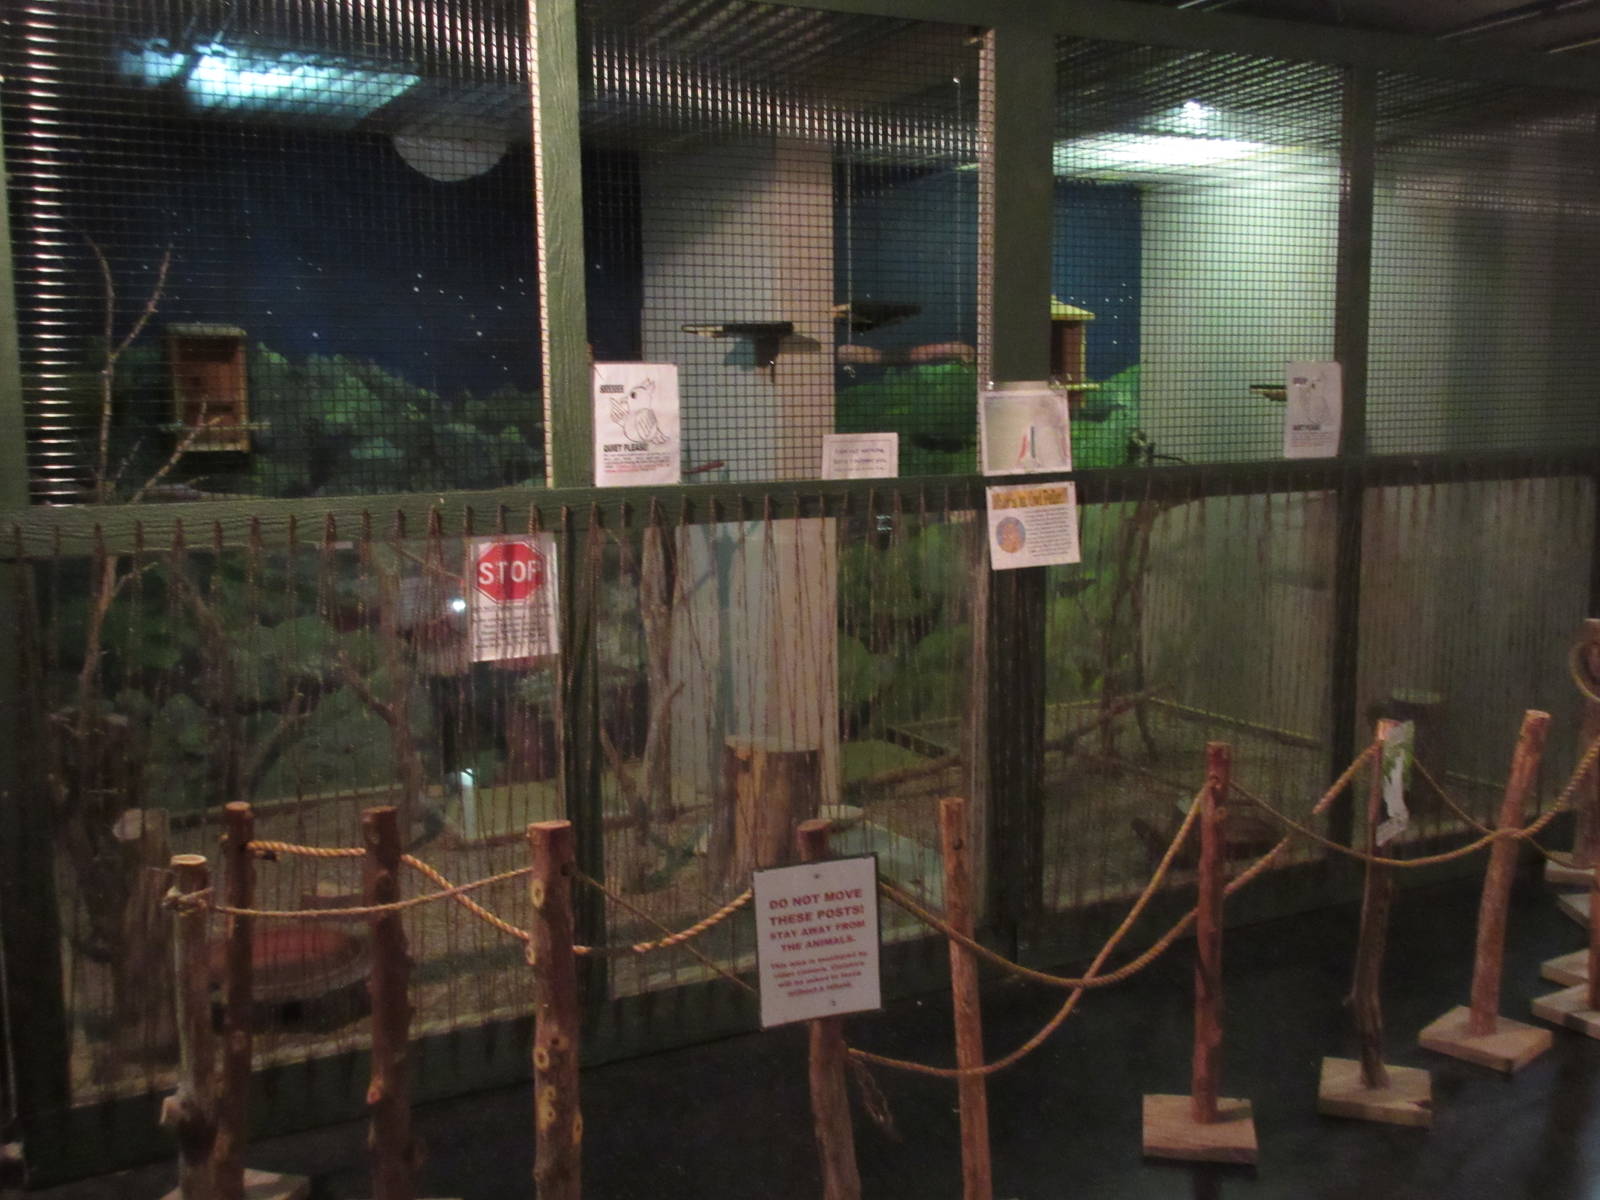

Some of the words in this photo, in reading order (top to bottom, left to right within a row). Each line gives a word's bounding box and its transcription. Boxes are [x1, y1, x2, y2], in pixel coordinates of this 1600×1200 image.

[478, 560, 541, 585] STOP
[769, 898, 788, 910] DO
[792, 894, 819, 906] NOT
[824, 888, 862, 901] MOVE
[769, 912, 812, 926] THESE
[817, 904, 864, 918] POSTS!
[769, 930, 797, 940] STAY
[801, 925, 831, 936] AWAY
[836, 919, 865, 930] FROM
[781, 943, 801, 952] THE
